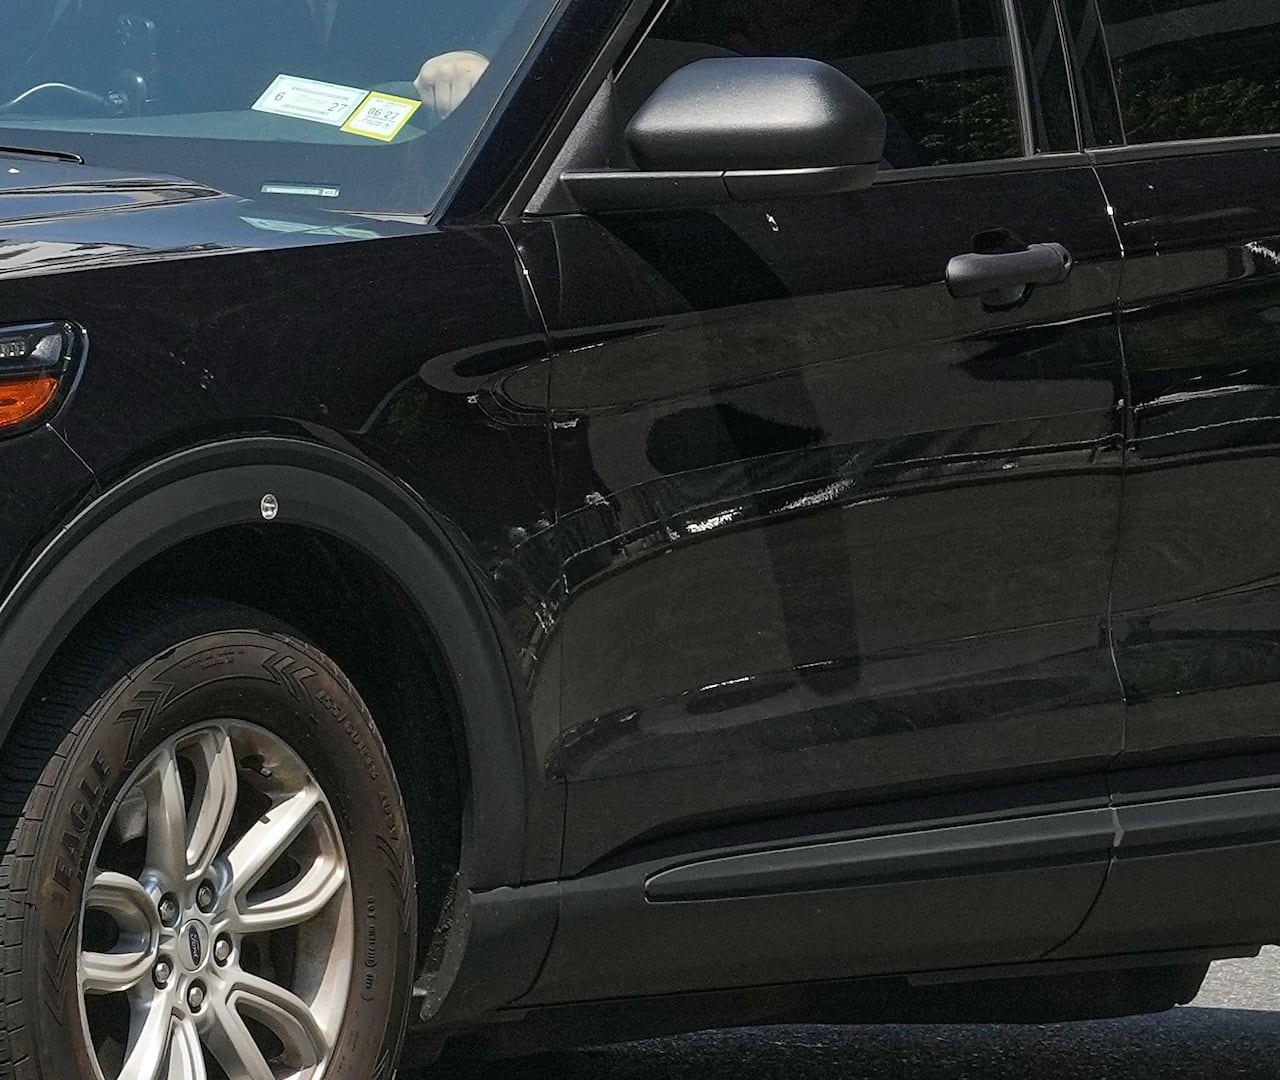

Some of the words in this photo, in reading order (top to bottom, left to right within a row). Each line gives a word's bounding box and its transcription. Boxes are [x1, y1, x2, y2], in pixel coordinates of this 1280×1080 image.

[273, 91, 286, 102] 6
[328, 102, 349, 113] 27
[51, 749, 111, 893] EAGLE
